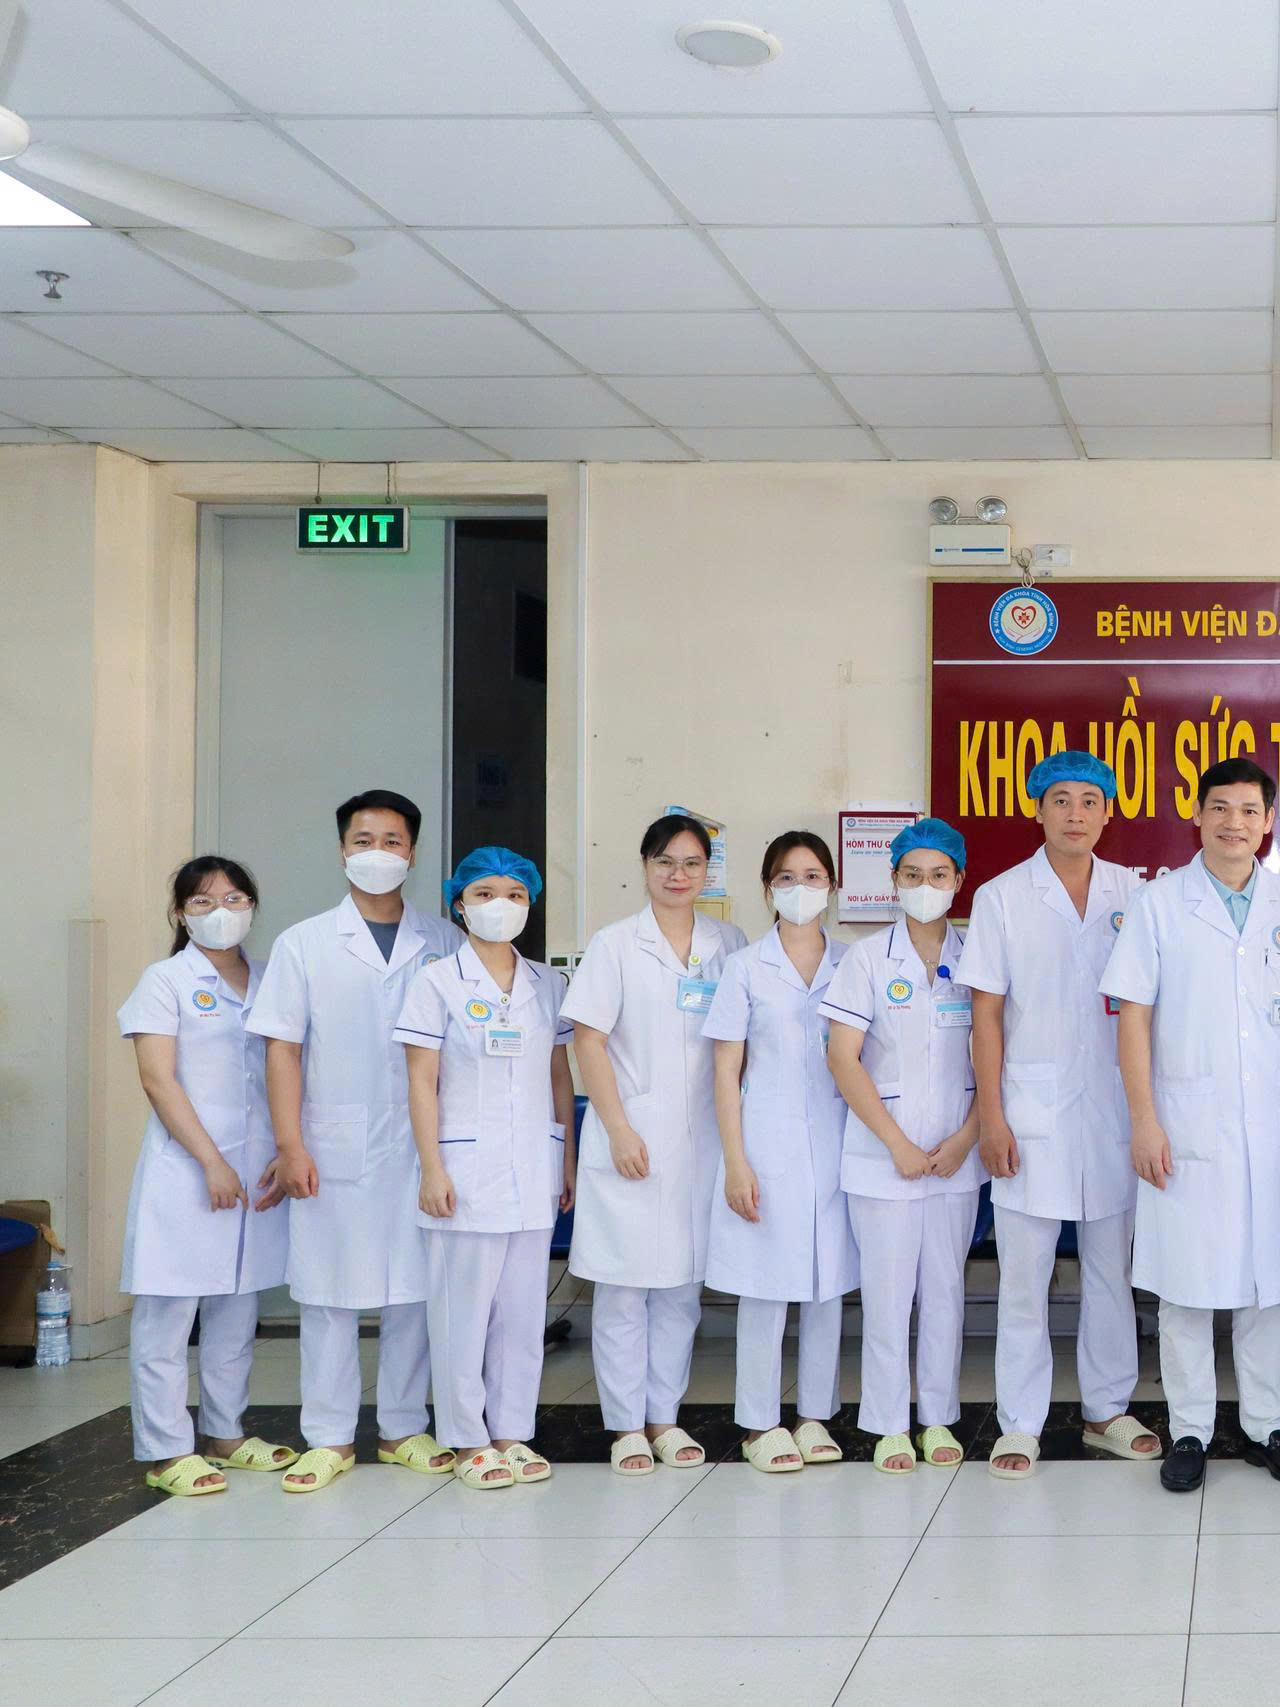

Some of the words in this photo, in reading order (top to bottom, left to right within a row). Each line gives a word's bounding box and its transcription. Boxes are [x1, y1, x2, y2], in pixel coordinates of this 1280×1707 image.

[308, 514, 394, 543] EXIT
[1096, 604, 1172, 644] BỆNH
[1181, 604, 1247, 644] VIỆN
